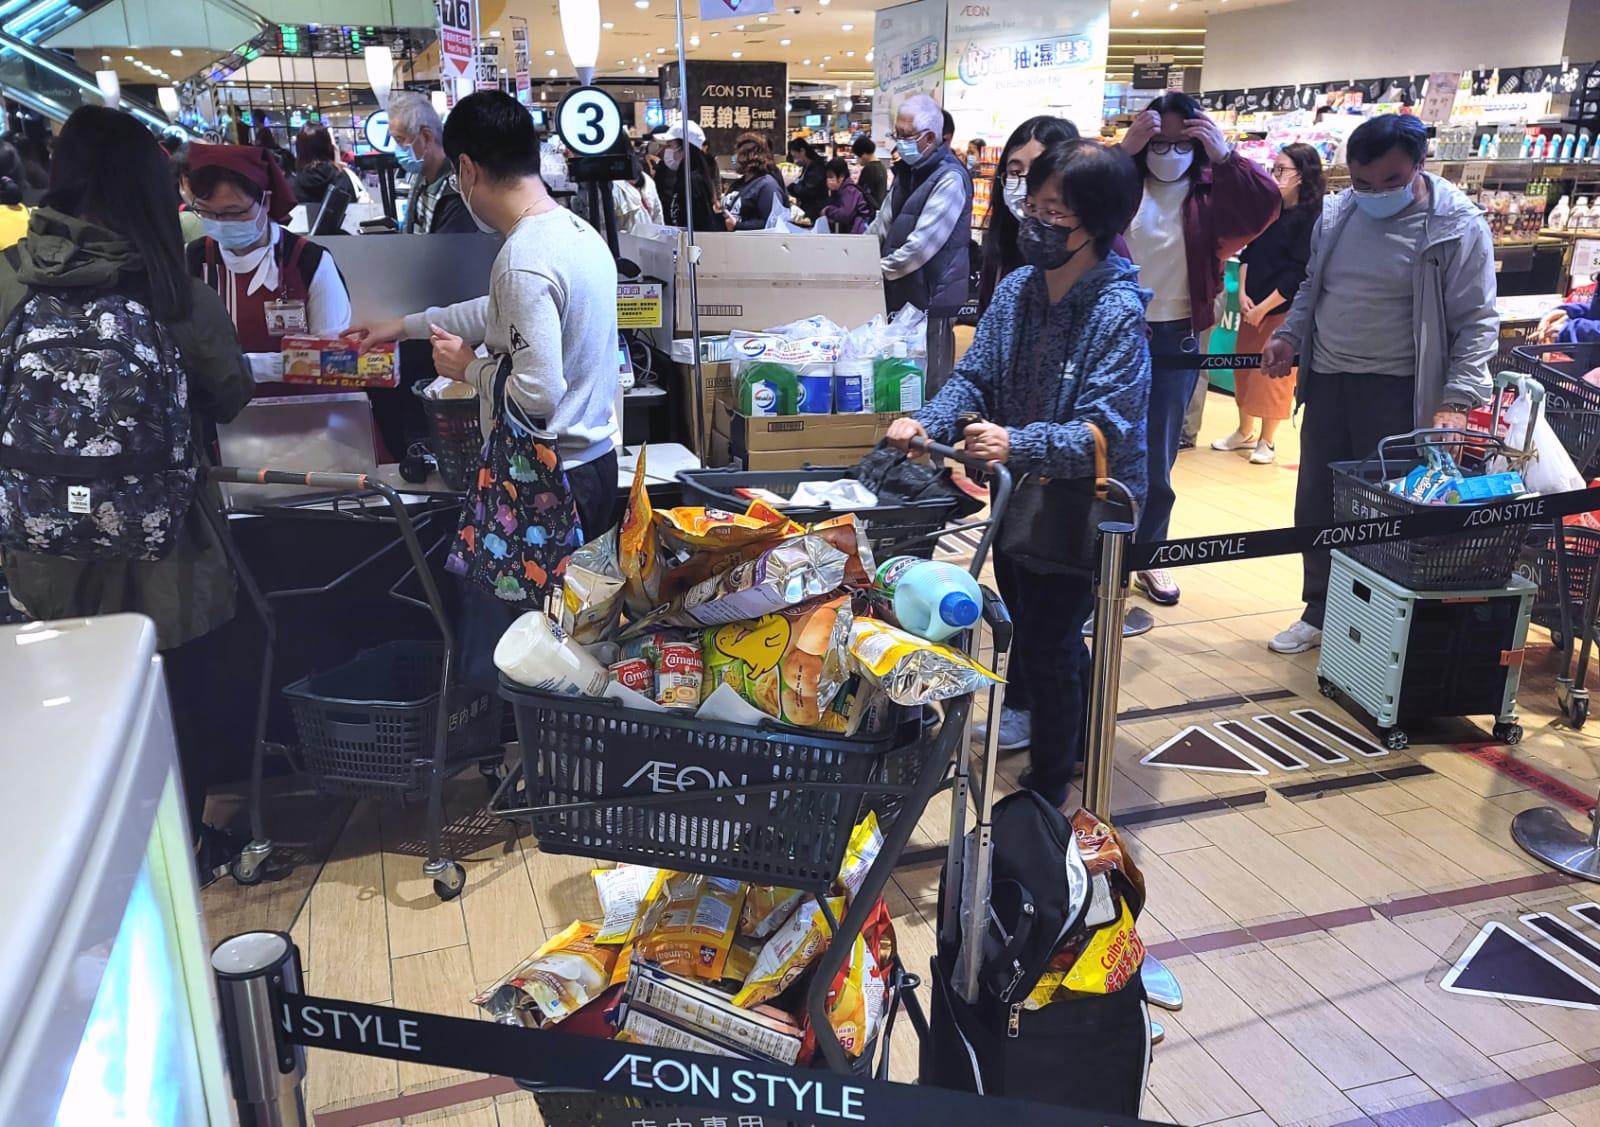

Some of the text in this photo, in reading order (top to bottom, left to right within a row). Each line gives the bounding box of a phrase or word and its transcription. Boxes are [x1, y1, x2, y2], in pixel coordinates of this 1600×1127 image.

[459, 4, 467, 26] 8
[737, 86, 773, 98] STYLE
[576, 101, 606, 146] 3
[700, 105, 751, 129] 展銷場
[752, 109, 776, 119] Event
[1234, 355, 1261, 367] STYL
[1503, 500, 1545, 521] STYLE
[1357, 520, 1402, 542] STYLE
[1197, 537, 1247, 560] STYLE
[1101, 929, 1128, 970] Calbee
[303, 1006, 421, 1051] STYLE
[732, 1070, 865, 1121] STYLE
